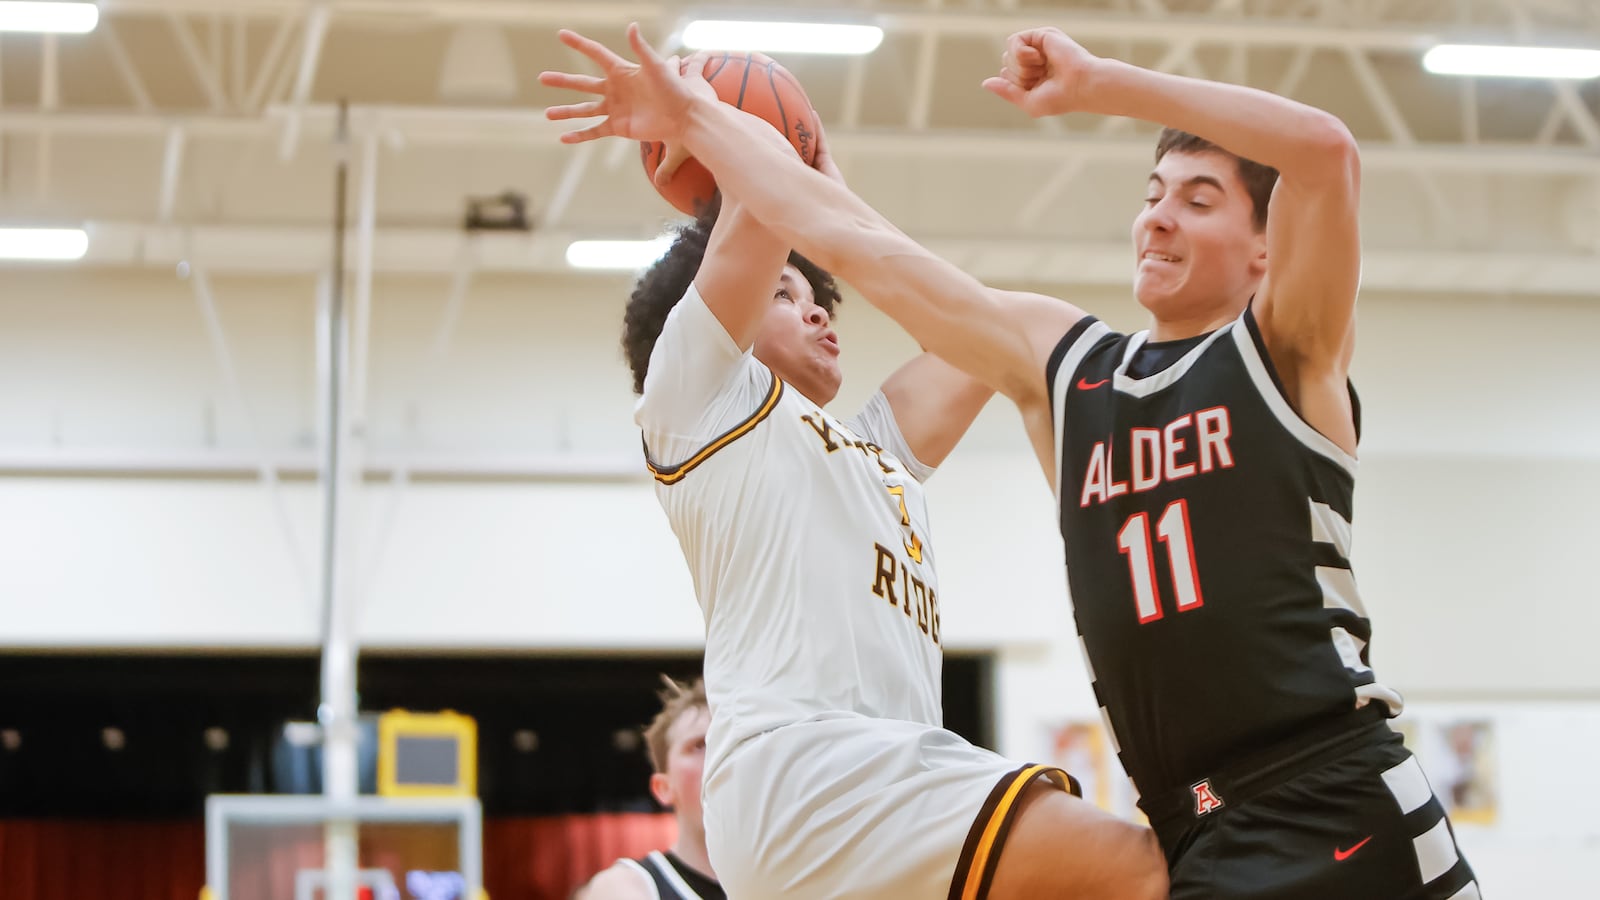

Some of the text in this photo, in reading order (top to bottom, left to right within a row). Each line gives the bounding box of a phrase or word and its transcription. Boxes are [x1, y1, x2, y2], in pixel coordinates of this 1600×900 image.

[1080, 405, 1235, 507] ALDER
[871, 541, 943, 650] RIDG
[1117, 498, 1204, 624] 11
[1192, 780, 1223, 815] A
